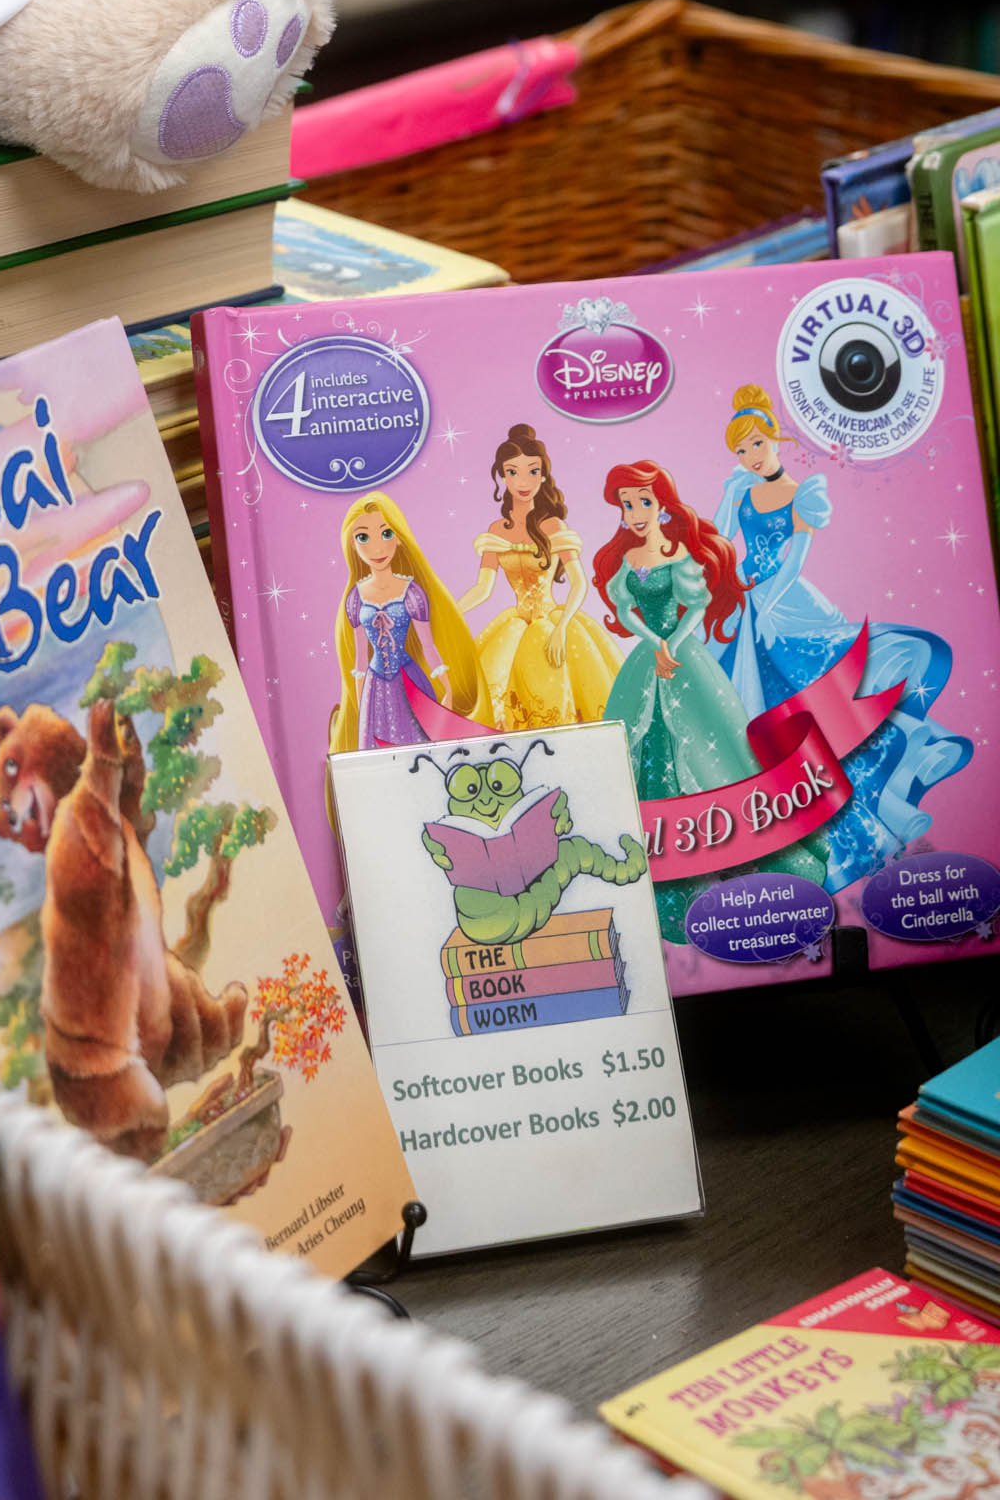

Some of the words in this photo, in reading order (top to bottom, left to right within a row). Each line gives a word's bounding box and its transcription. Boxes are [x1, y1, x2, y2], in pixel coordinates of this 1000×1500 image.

[791, 294, 890, 365] VIRTUAL
[892, 315, 927, 358] 3D
[310, 371, 368, 388] includes
[573, 385, 645, 401] PRINCESS
[923, 366, 937, 397] LIFE
[265, 371, 312, 439] 4
[311, 385, 414, 411] interactive
[788, 379, 817, 427] DISNEY
[813, 396, 830, 417] USE
[827, 410, 838, 423] A
[838, 413, 892, 433] WEBCAM
[891, 404, 905, 422] TO
[901, 389, 917, 411] SEE
[915, 393, 932, 417] TO
[309, 411, 420, 437] animations!
[816, 421, 890, 450] PRINCESSES
[890, 414, 923, 445] COME
[674, 801, 734, 853] 3D
[741, 760, 834, 835] Book
[899, 869, 942, 886] Dress
[946, 865, 967, 882] for
[721, 890, 756, 909] Help
[759, 885, 795, 903] Ariel
[891, 894, 916, 909] the
[919, 889, 945, 906] ball
[948, 884, 979, 902] with
[691, 915, 741, 934] collect
[744, 905, 829, 928] underwater
[901, 908, 975, 930] Cinderella
[729, 931, 797, 951] treasures
[464, 946, 506, 971] THE
[469, 973, 527, 1000] BOOK
[473, 1002, 538, 1029] WORM
[393, 1067, 506, 1102] Softcover
[512, 1056, 584, 1088] Books
[602, 1046, 666, 1079] $1.50
[399, 1116, 522, 1153] Hardcover
[530, 1106, 601, 1136] Books
[612, 1095, 677, 1127] $2.00
[263, 1208, 310, 1252] Bernard
[309, 1186, 345, 1219] Libster
[296, 1230, 324, 1255] Aries
[323, 1197, 366, 1237] Cheung
[667, 1375, 729, 1410] TEN
[718, 1335, 810, 1385] LITTLE
[697, 1348, 853, 1437] MONKEYS
